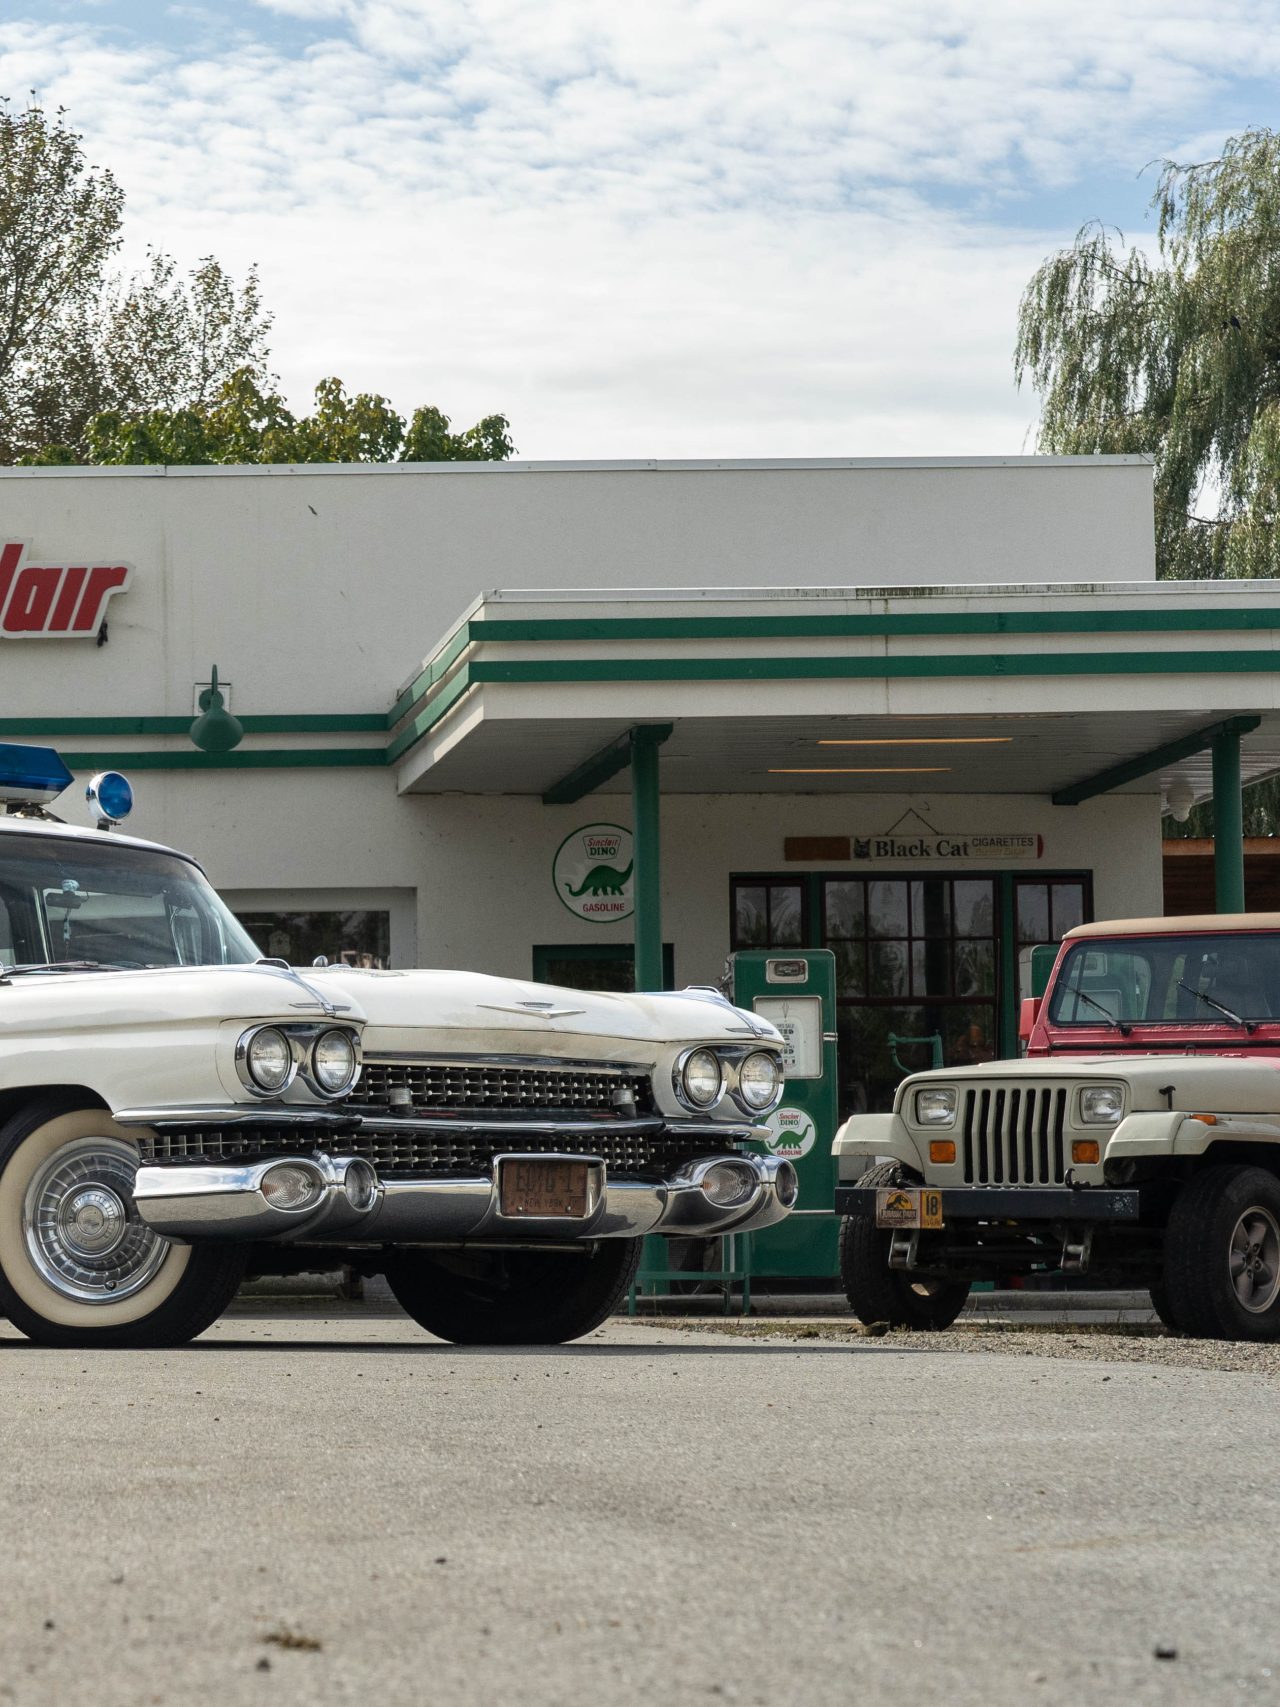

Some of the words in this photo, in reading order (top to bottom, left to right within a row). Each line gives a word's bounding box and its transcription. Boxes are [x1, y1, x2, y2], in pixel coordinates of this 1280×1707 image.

[587, 838, 618, 847] Sinclair
[589, 847, 616, 856] DINO
[874, 839, 931, 858] Black
[936, 839, 970, 857] Cat
[972, 837, 1034, 848] CIGARETTES
[582, 903, 625, 912] GASOLINE
